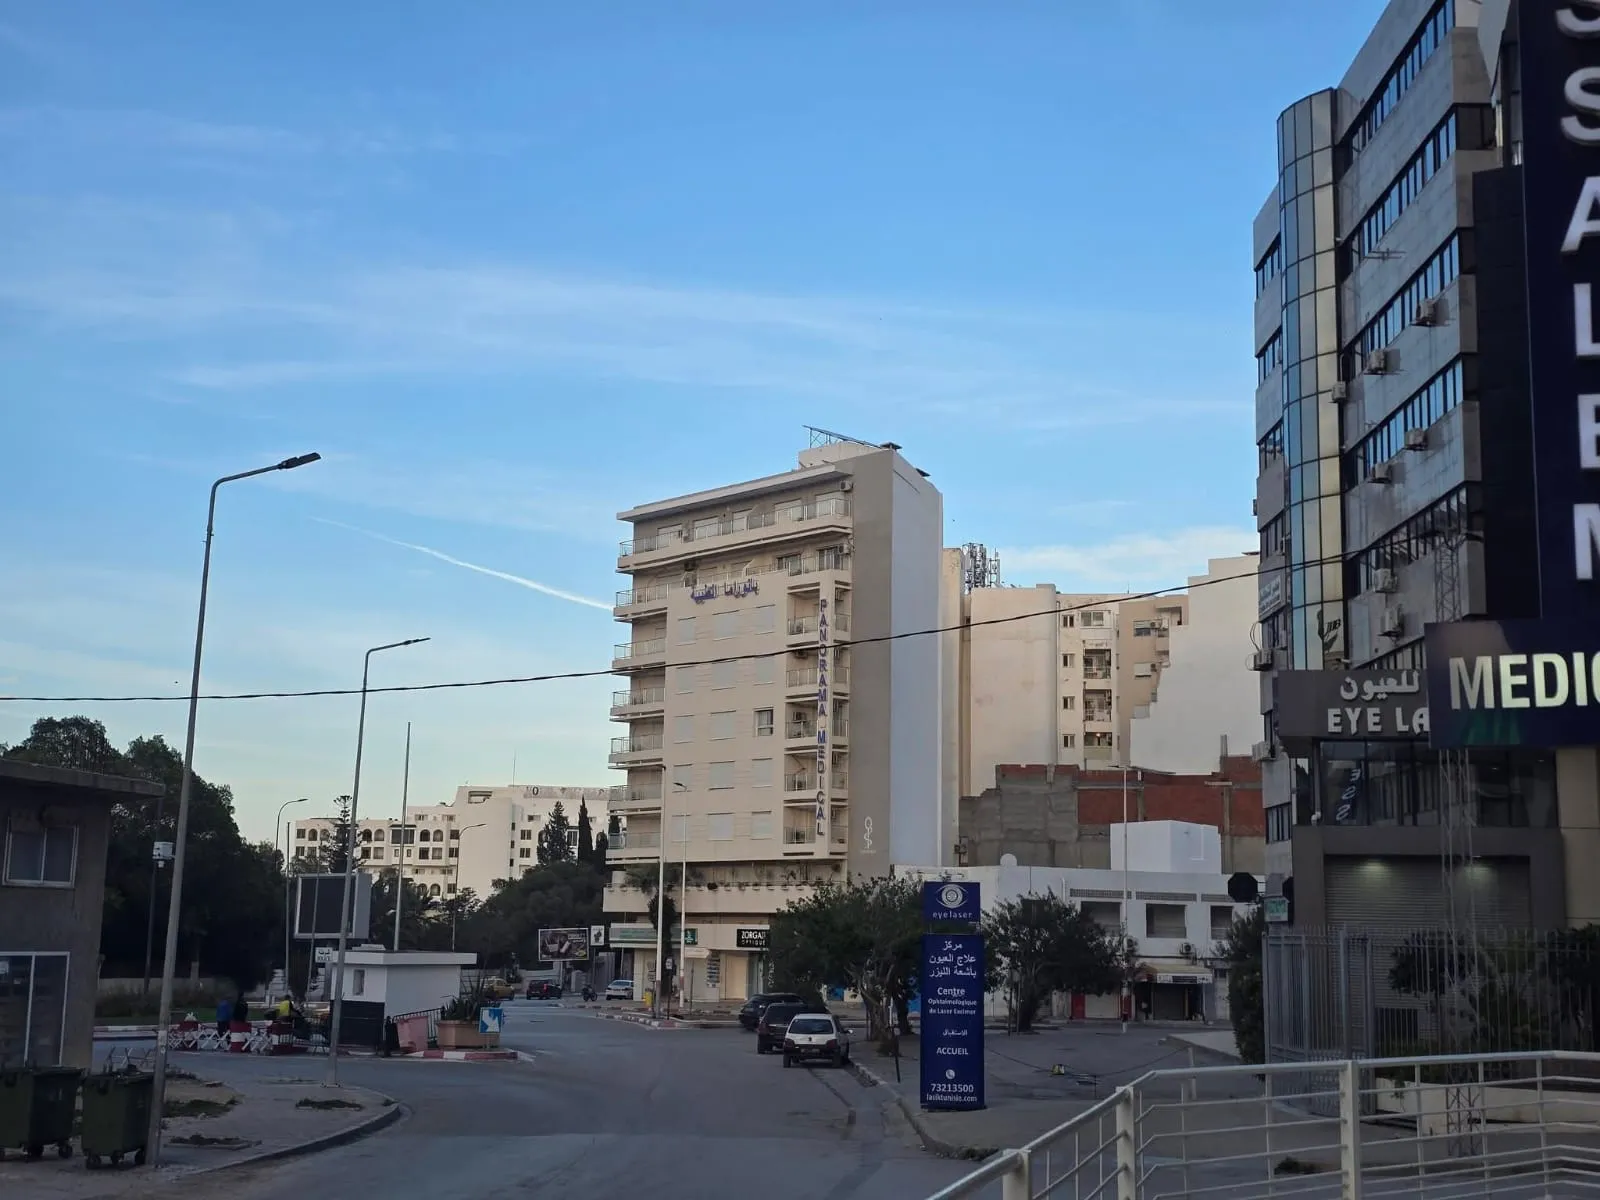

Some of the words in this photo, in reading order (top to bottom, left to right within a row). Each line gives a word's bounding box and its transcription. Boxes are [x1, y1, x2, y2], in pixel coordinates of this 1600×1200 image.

[817, 599, 829, 717] PANORAMA
[1340, 670, 1420, 701] للعيون
[1327, 707, 1382, 736] EYE
[816, 729, 827, 836] MEDICAL
[932, 910, 973, 920] eyelaser
[942, 940, 963, 951] مركز
[929, 954, 954, 965] العيون
[956, 954, 976, 966] علاج
[953, 966, 977, 979] بأشعة
[937, 987, 966, 996] Centre
[936, 1047, 969, 1056] ACCUEIL
[930, 1083, 974, 1093] 73213500
